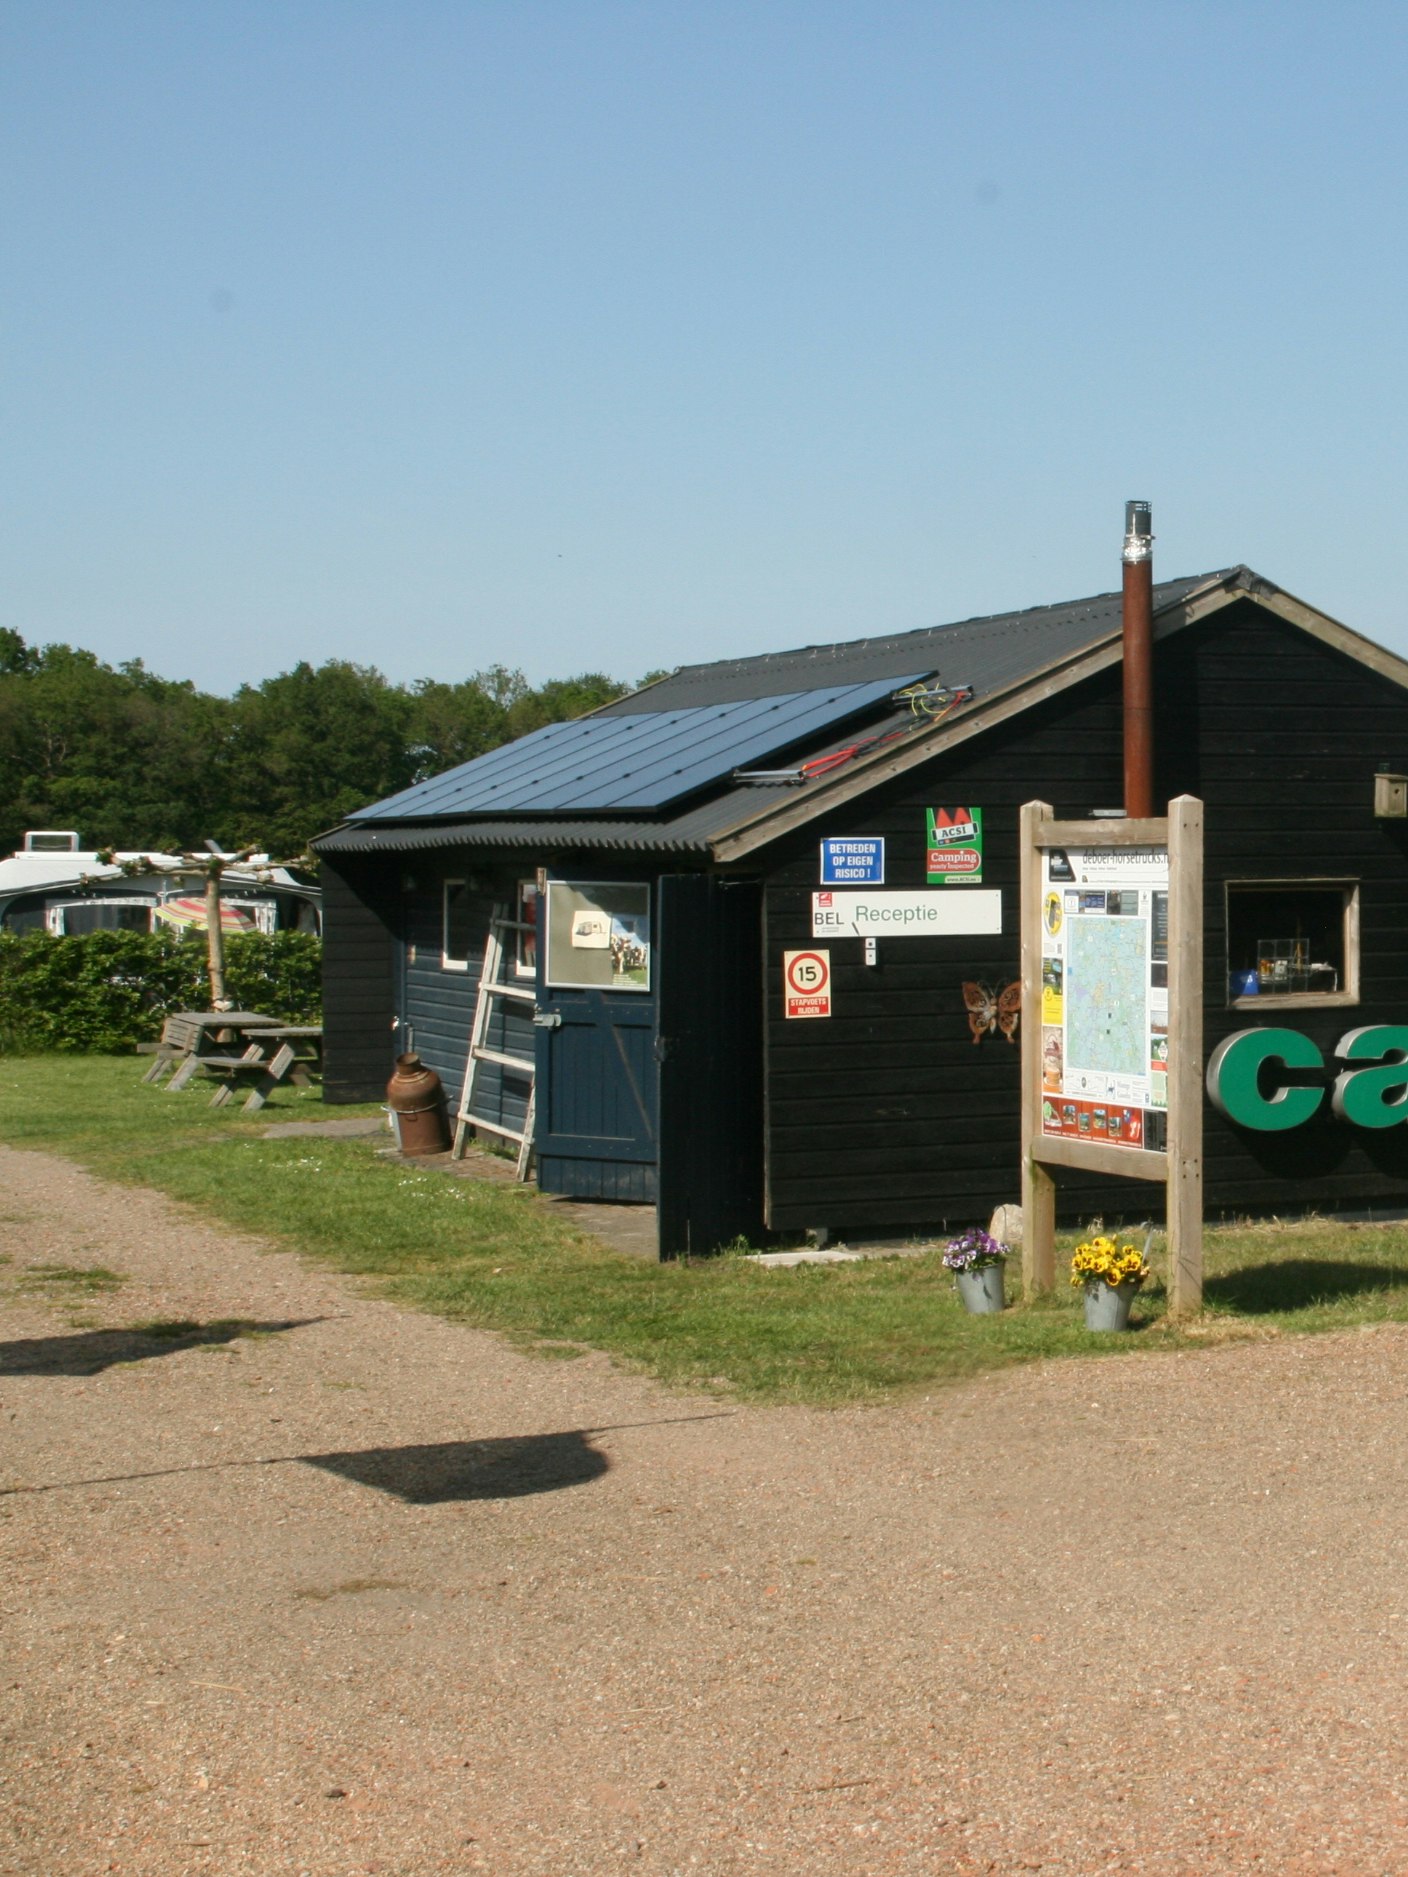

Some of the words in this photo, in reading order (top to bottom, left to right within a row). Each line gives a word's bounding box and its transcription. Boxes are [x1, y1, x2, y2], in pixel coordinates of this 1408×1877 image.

[942, 826, 967, 838] ACSI
[829, 843, 876, 854] BETREDEN
[832, 856, 846, 866] OP
[847, 856, 873, 866] EIGEN
[931, 850, 977, 863] Camping
[835, 868, 865, 879] RISICO
[814, 911, 845, 925] BEL
[855, 904, 938, 925] Receptie
[798, 966, 817, 982] 15
[790, 997, 827, 1007] STAPVOETS
